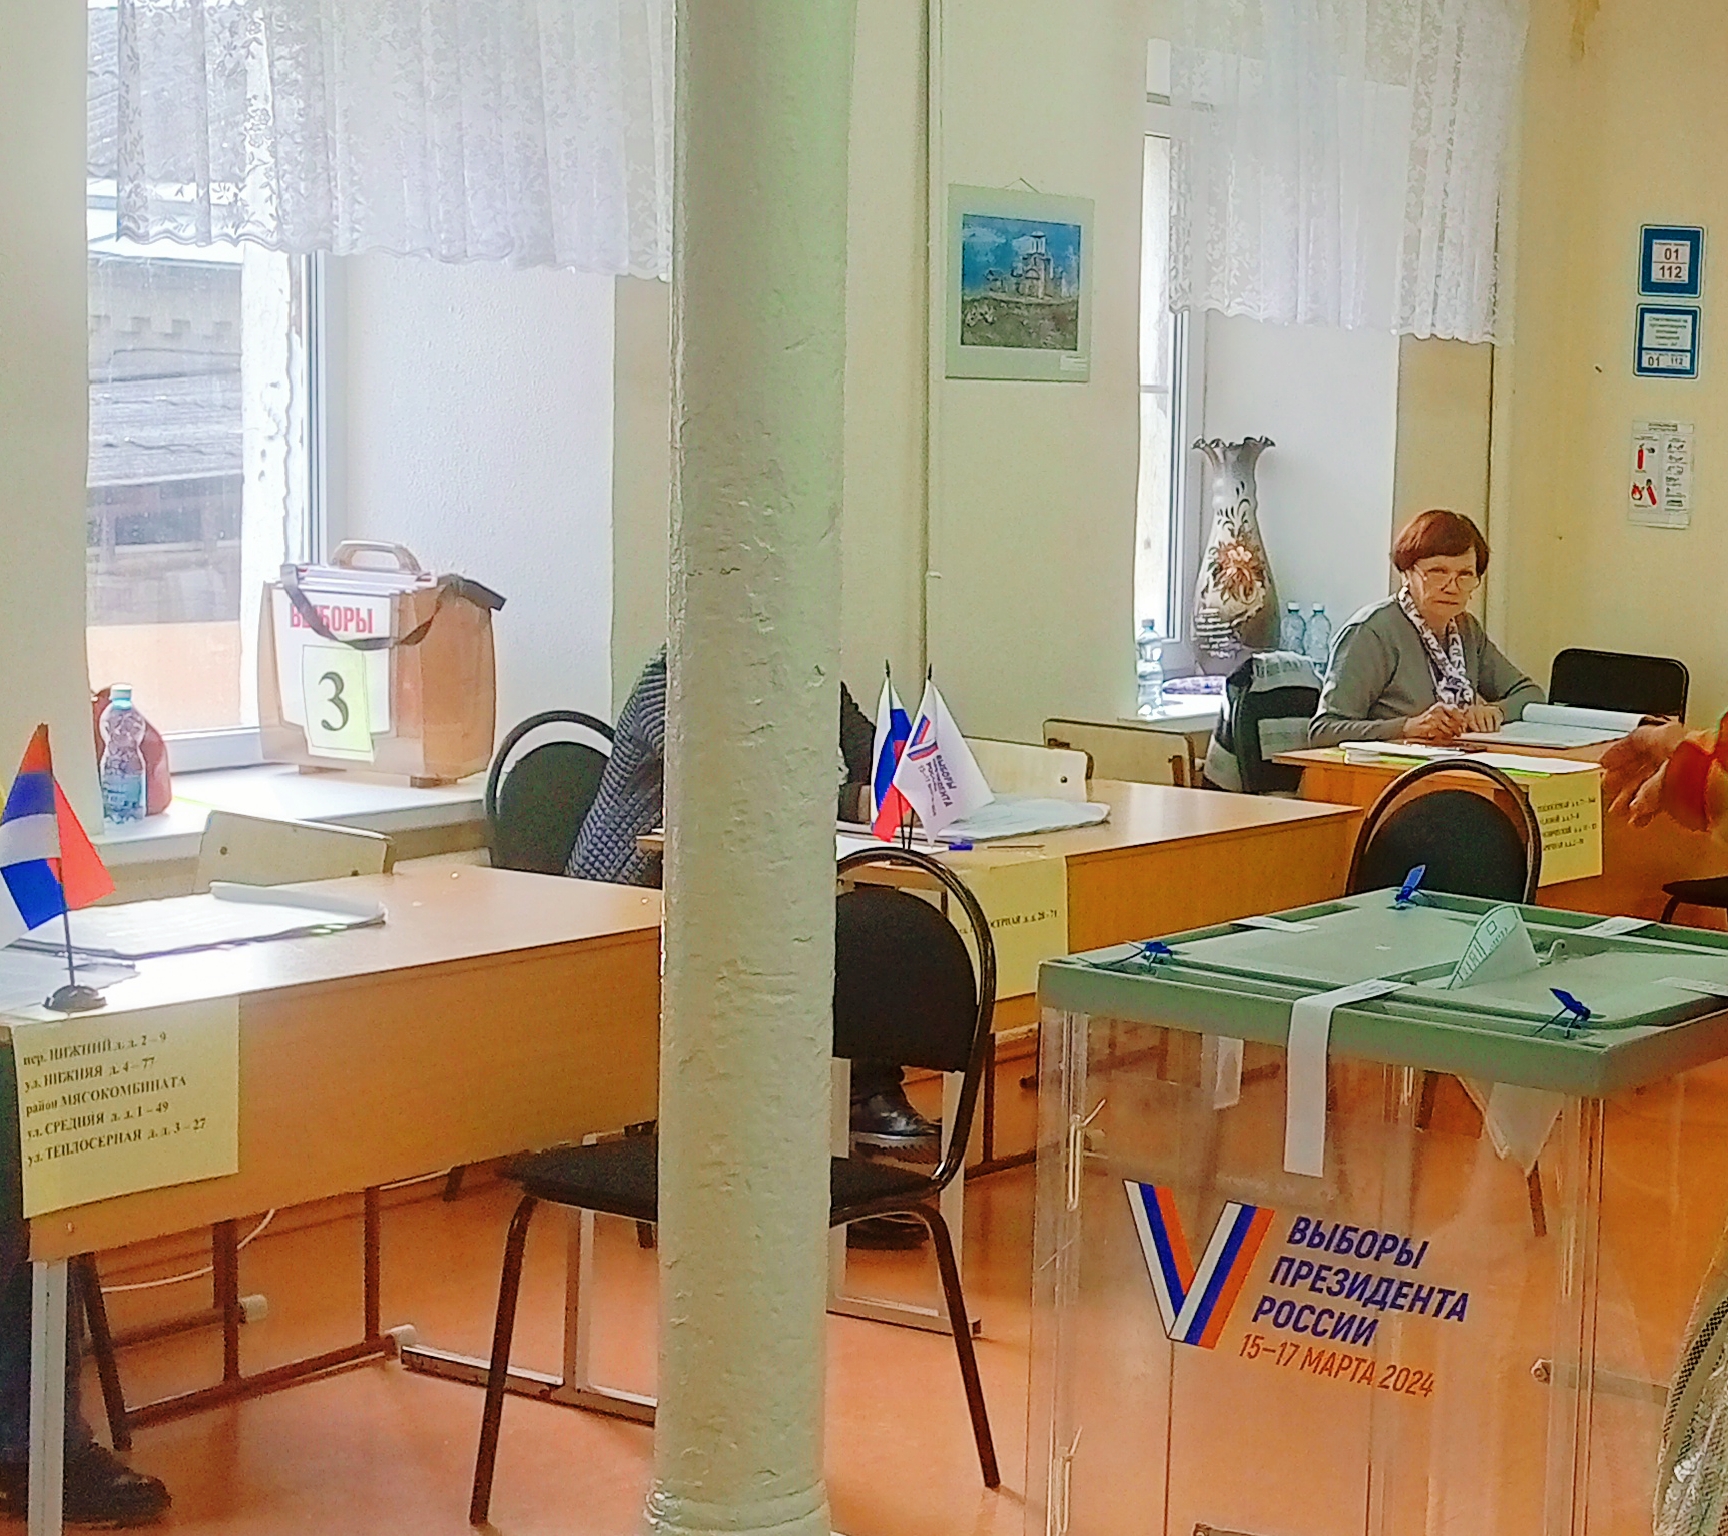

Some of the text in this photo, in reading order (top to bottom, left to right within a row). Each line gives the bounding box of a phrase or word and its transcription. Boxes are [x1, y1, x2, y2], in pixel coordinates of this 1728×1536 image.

[1659, 265, 1682, 278] 112
[1664, 248, 1679, 261] 01
[1648, 356, 1660, 366] 01
[290, 602, 374, 634] ВБОРЫ
[318, 671, 350, 731] 3
[50, 1038, 111, 1061] НИЖНИЙ
[44, 1065, 103, 1087] НИЖНЯЯ
[142, 1056, 155, 1069] 77
[26, 1076, 187, 1117] район МЯСОКОМБИНАТА
[45, 1112, 105, 1136] СРЕДНЯЯ
[155, 1101, 169, 1113] 49
[45, 1129, 142, 1161] ТЕПЛОСЕРНАЯ
[193, 1117, 206, 1131] 27
[1286, 1215, 1431, 1270] ВЫБОРЫ
[1269, 1255, 1471, 1323] ПРЕЗИДЕНТА
[1251, 1294, 1378, 1348] РОССИИ
[1300, 1346, 1375, 1388] МАРТА
[1377, 1364, 1438, 1398] 2024
